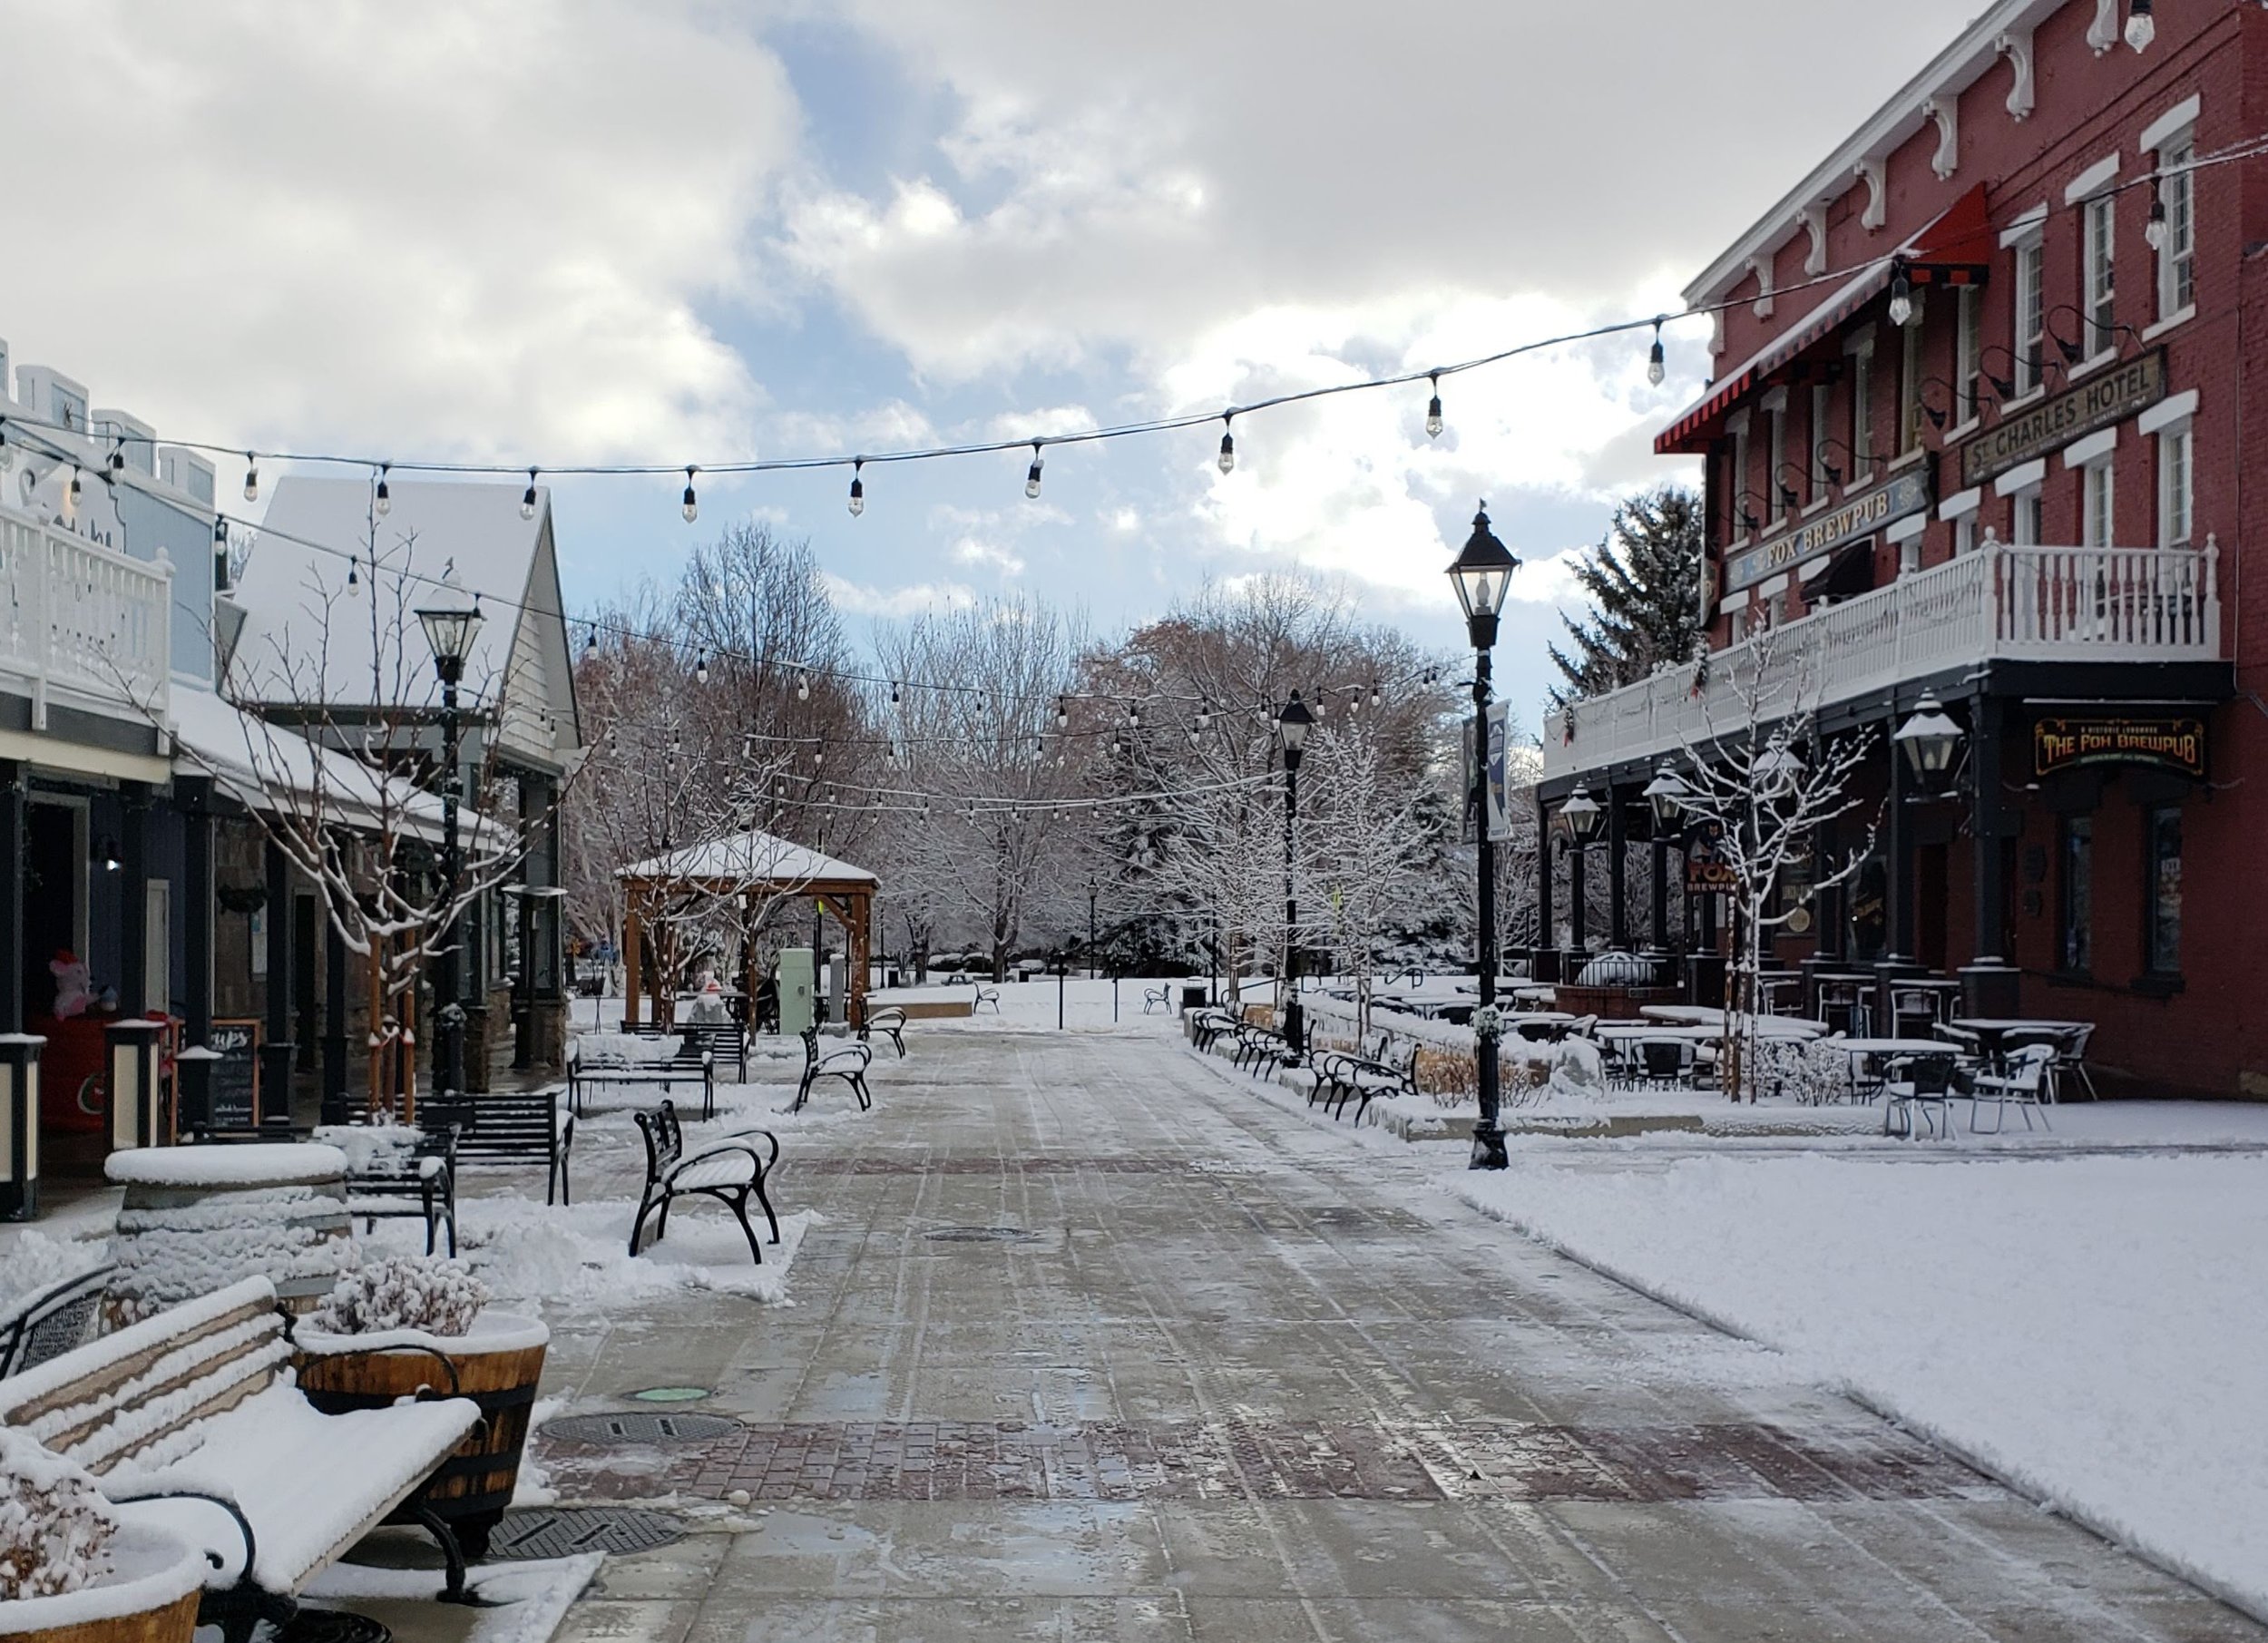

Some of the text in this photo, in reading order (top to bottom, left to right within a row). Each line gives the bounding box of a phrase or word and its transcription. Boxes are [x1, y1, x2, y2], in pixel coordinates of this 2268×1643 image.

[1996, 397, 2077, 455] CHARLES
[2087, 364, 2150, 414] HOTEL
[1767, 536, 1797, 568] FOX
[1801, 492, 1889, 552] BREWPUB
[2043, 734, 2075, 763] THE
[2117, 734, 2196, 764] BREWPUB
[1687, 883, 1736, 891] BREWPU
